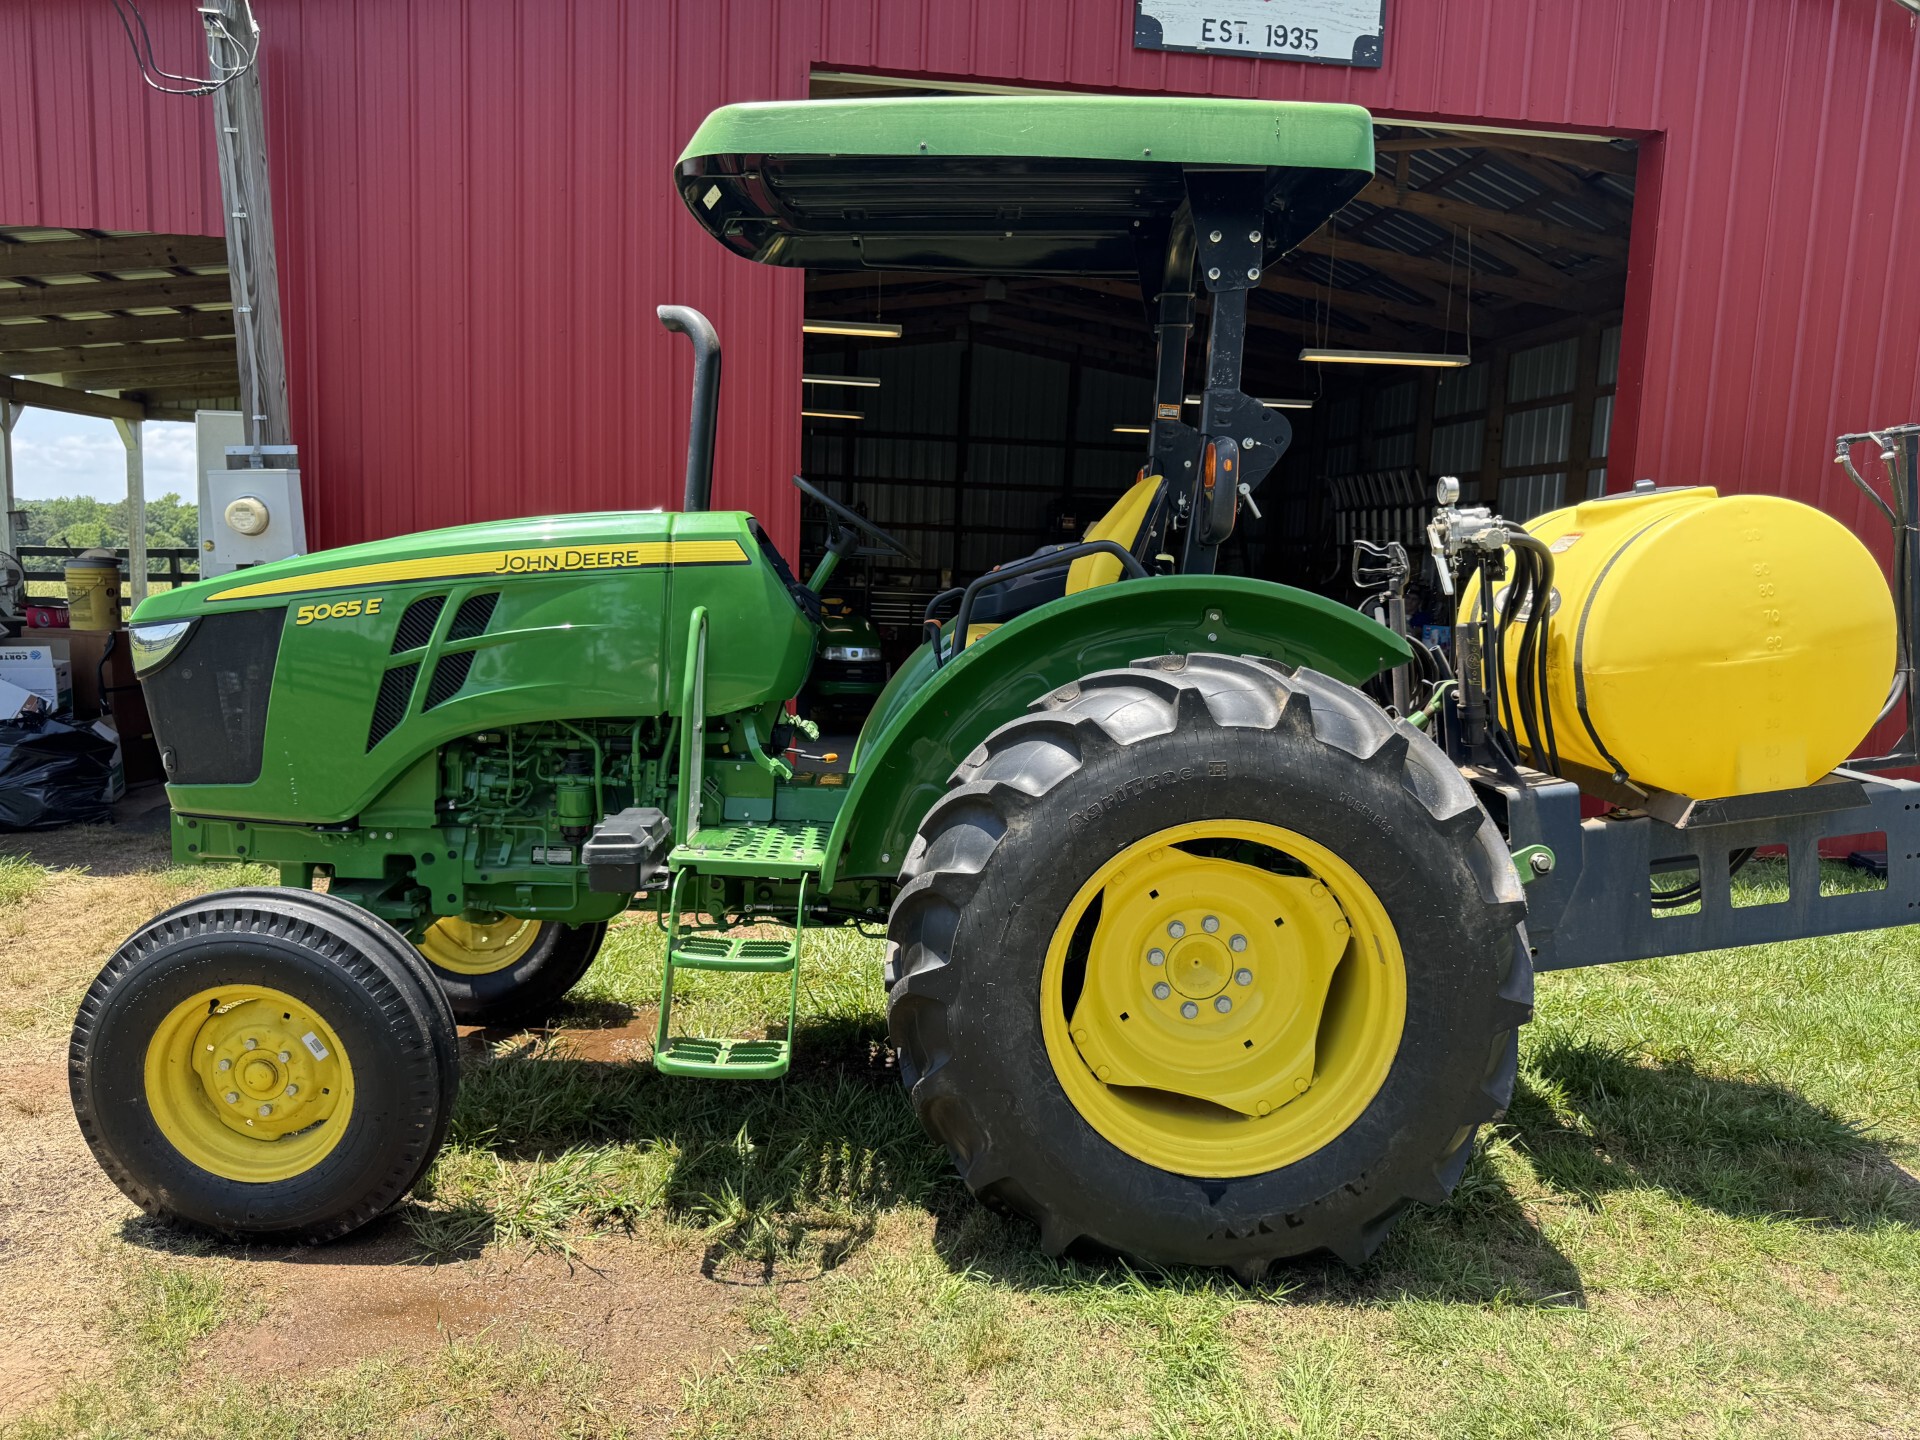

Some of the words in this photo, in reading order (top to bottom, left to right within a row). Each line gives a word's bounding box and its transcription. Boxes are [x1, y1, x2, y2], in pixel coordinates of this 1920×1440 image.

[1202, 18, 1250, 45] EST.
[1265, 24, 1319, 51] 1935
[496, 553, 559, 572] JOHN
[564, 550, 640, 569] DEERE
[296, 600, 363, 626] 5065
[365, 598, 383, 616] E
[1763, 609, 1780, 623] 70
